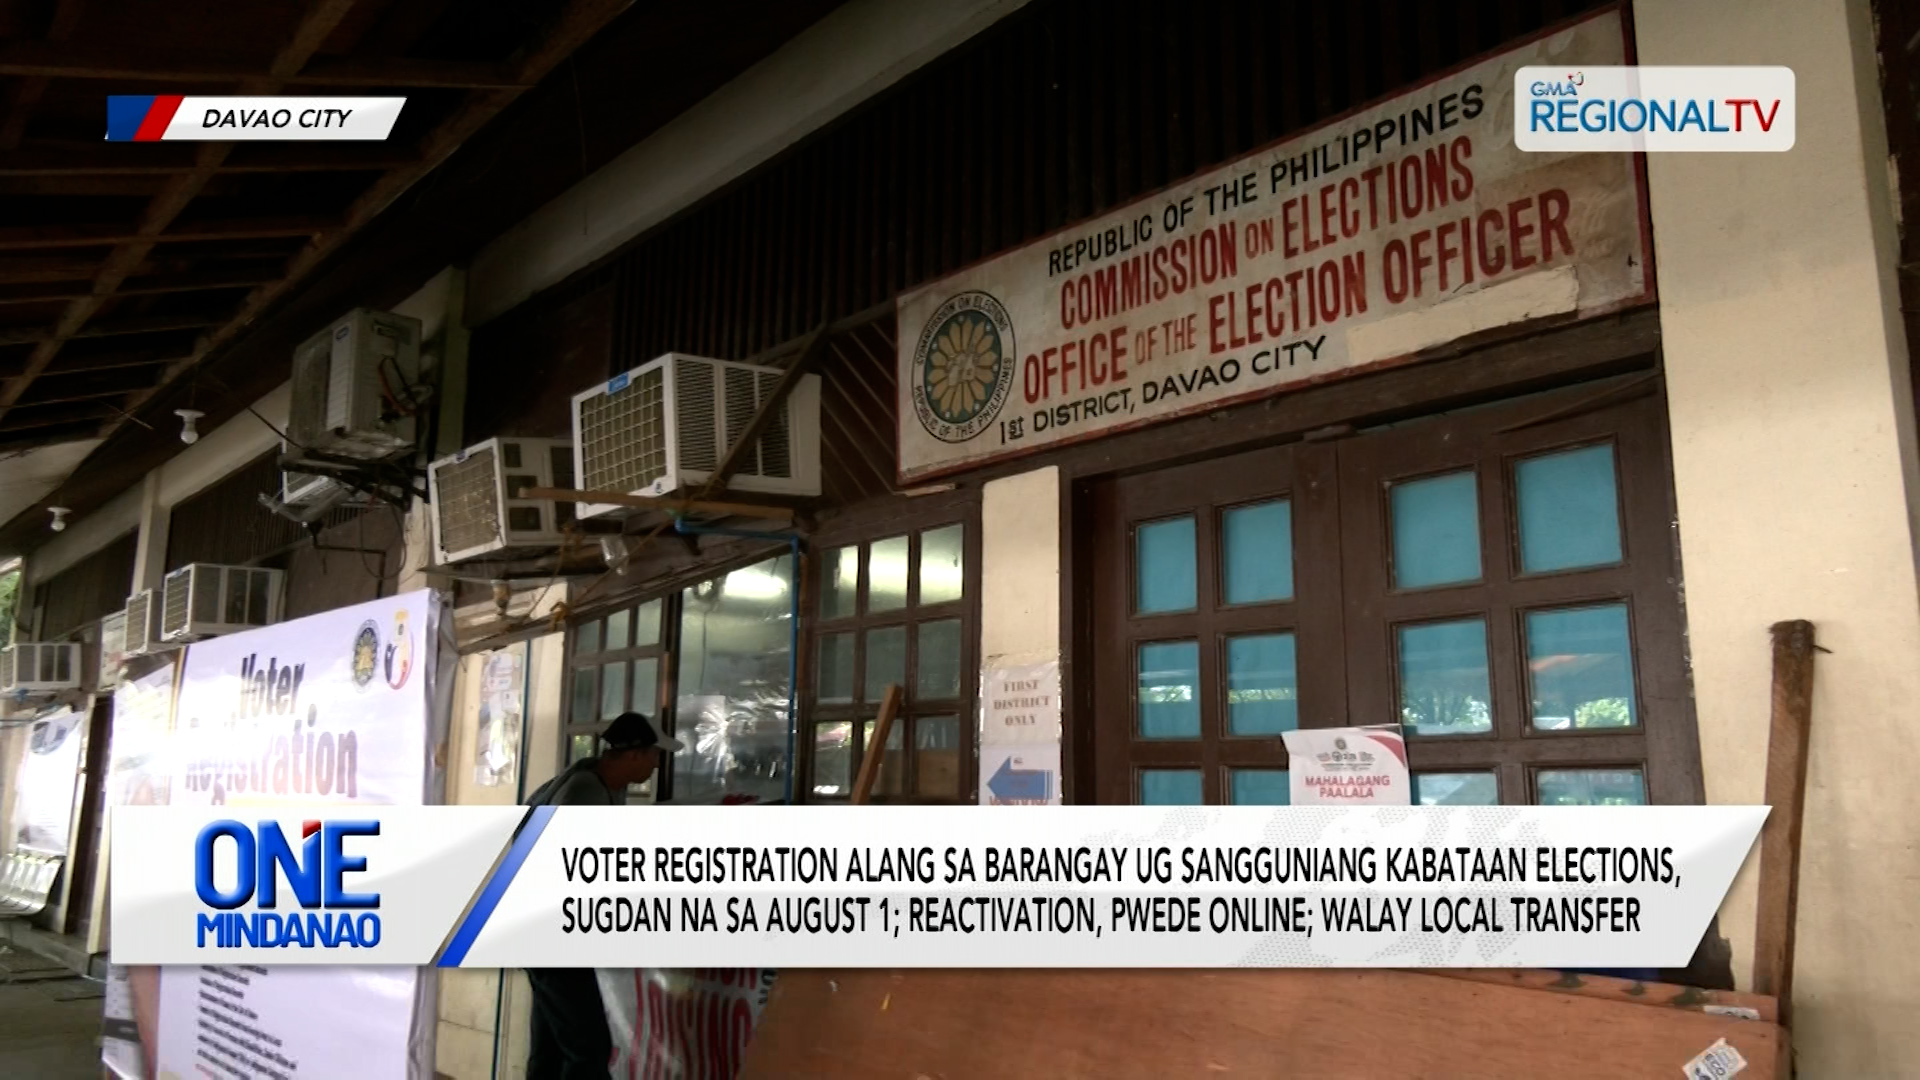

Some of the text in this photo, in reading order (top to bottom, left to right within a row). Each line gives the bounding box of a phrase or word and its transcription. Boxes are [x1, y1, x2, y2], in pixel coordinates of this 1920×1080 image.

[1049, 84, 1485, 277] REPUBLIC OF THE PHILIPPINES
[1060, 135, 1475, 330] COMMISSION ON ELECTIONS
[1024, 188, 1575, 404] OFFICE OF THE ELECTION OFFICER
[1000, 334, 1326, 445] 1st DISTRICT, DAVAO CITY
[938, 424, 951, 439] OF
[954, 421, 977, 439] THE
[240, 652, 306, 719] Voter
[1003, 680, 1041, 693] FIRST
[993, 695, 1051, 711] DISTRICT
[1004, 713, 1037, 727] ONLY
[1304, 774, 1391, 787] MAHALAGANG
[1319, 786, 1375, 799] PAALALA
